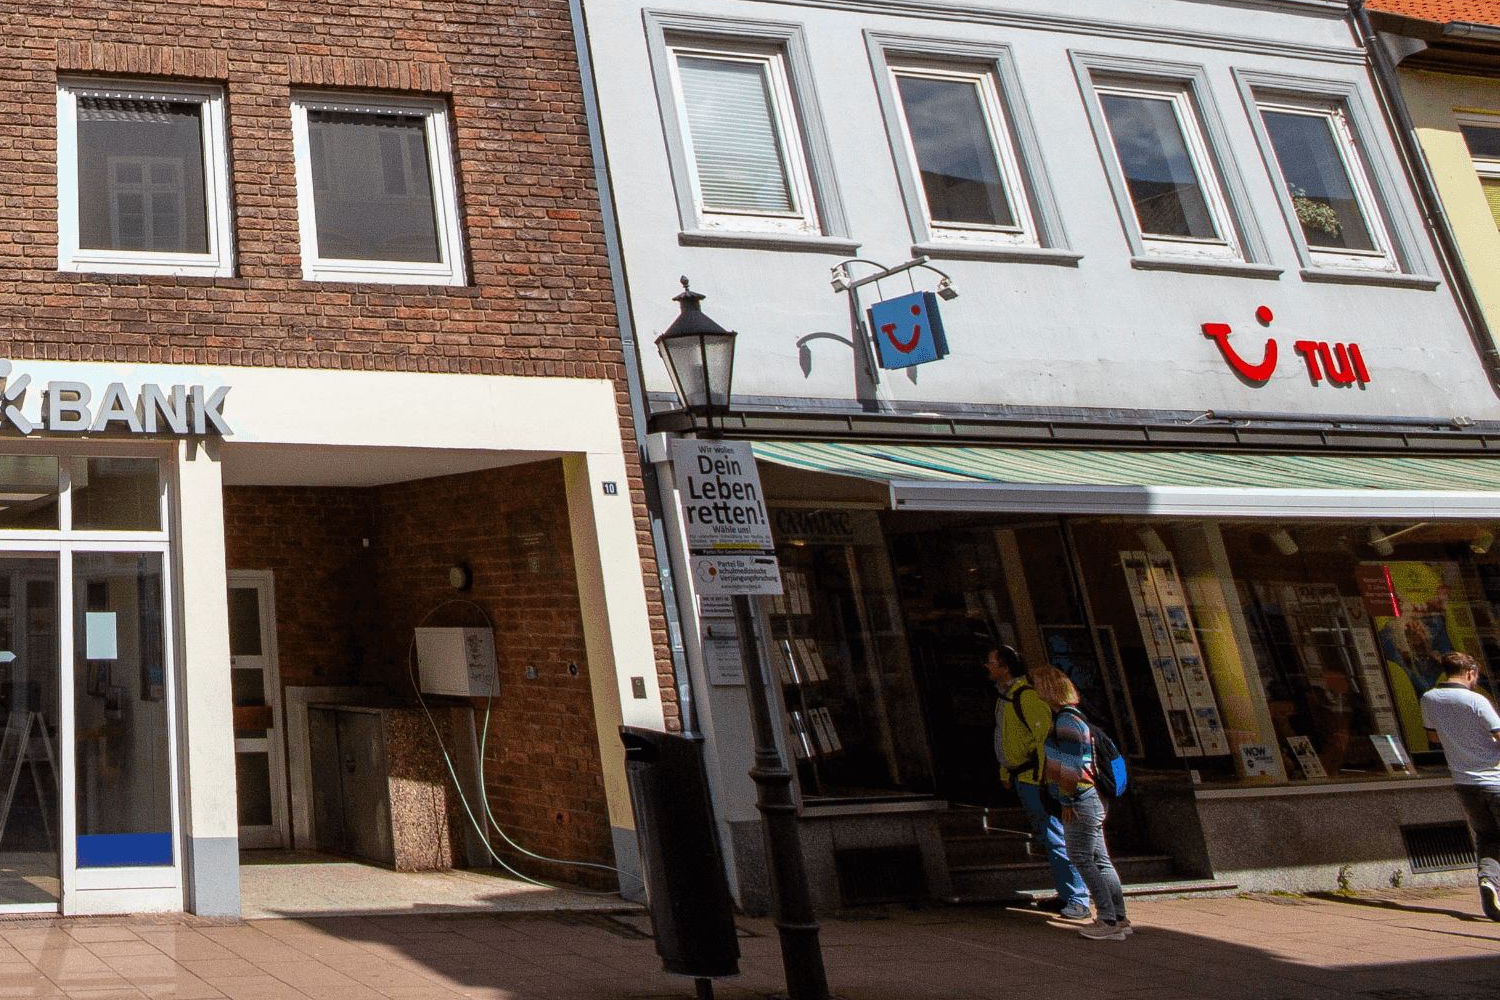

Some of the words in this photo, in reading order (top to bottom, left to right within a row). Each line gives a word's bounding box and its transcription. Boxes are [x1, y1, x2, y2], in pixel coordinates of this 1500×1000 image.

[1294, 340, 1371, 384] TUI
[48, 381, 235, 436] BANK
[698, 445, 712, 453] Wir
[714, 446, 735, 454] wollen
[697, 455, 742, 476] Dein
[605, 483, 615, 494] 10
[687, 475, 756, 501] Leben
[686, 500, 766, 525] retten!
[712, 525, 737, 534] Wähle
[737, 526, 752, 534] uns!
[1242, 747, 1266, 756] WOW
